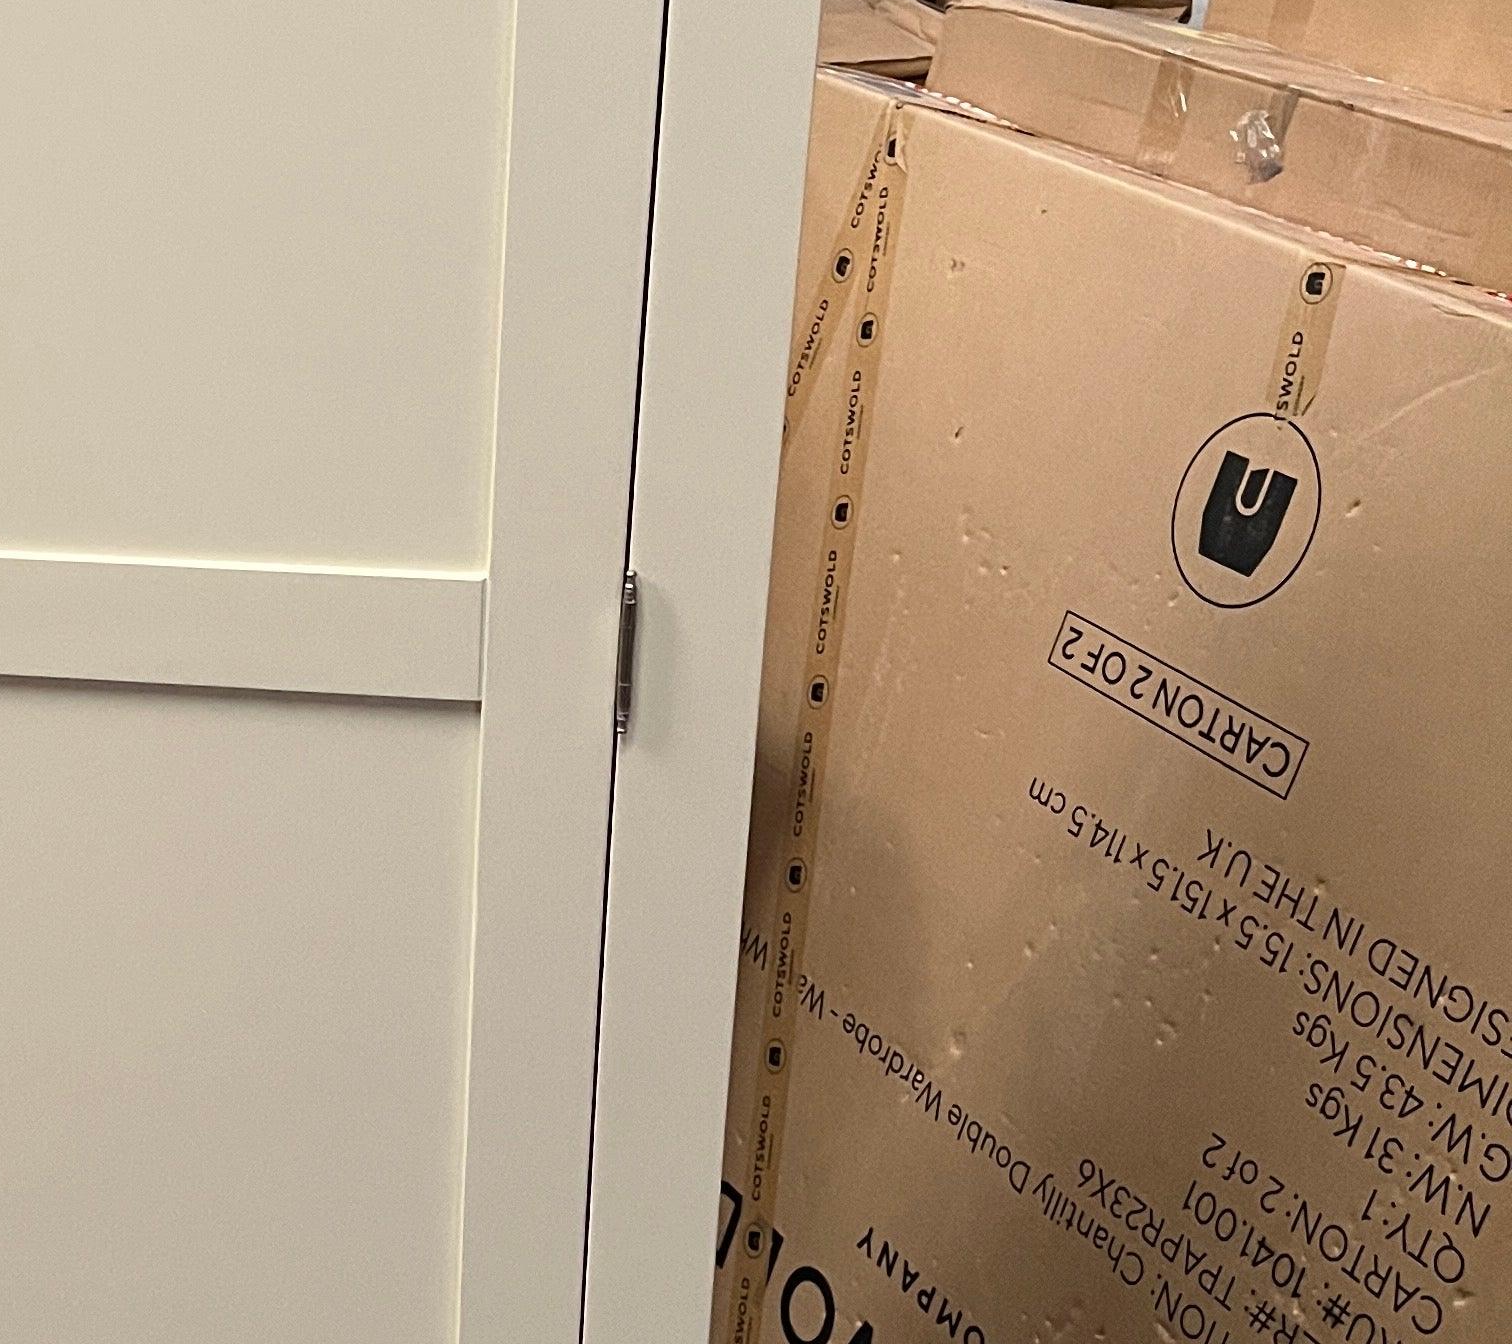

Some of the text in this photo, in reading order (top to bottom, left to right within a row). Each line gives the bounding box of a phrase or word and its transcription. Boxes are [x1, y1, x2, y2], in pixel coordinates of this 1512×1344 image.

[866, 186, 889, 292] COTSWOLD
[788, 299, 829, 397] COTSWOLD
[840, 369, 862, 475] COTSWOLD
[816, 550, 837, 655] COTSWOLD
[1061, 626, 1291, 778] CARTON 2 OF 2
[793, 731, 814, 837] COTSWOLD
[1028, 777, 1066, 814] cm
[1067, 805, 1127, 864] 114.5
[1147, 858, 1213, 920] 151.5
[772, 912, 792, 1018] COTSWOLD
[1197, 828, 1512, 1058] SIGNED IN THE U.K
[1235, 915, 1294, 974] 15.5
[842, 1013, 943, 1122] Wardrobe
[1292, 1011, 1511, 1183] G.W: 43.5 Kgs
[751, 1094, 772, 1202] COTSWOLD
[947, 1103, 1031, 1195] Double
[1305, 1083, 1492, 1239] N.W: 31 Kgs
[1032, 1173, 1144, 1286] Chantilly
[1078, 1158, 1237, 1312] TPAPR23X6
[1182, 1180, 1306, 1299] 1041.001
[1202, 1132, 1443, 1335] CARTON: 2 of 2
[1383, 1202, 1465, 1284] QTY:
